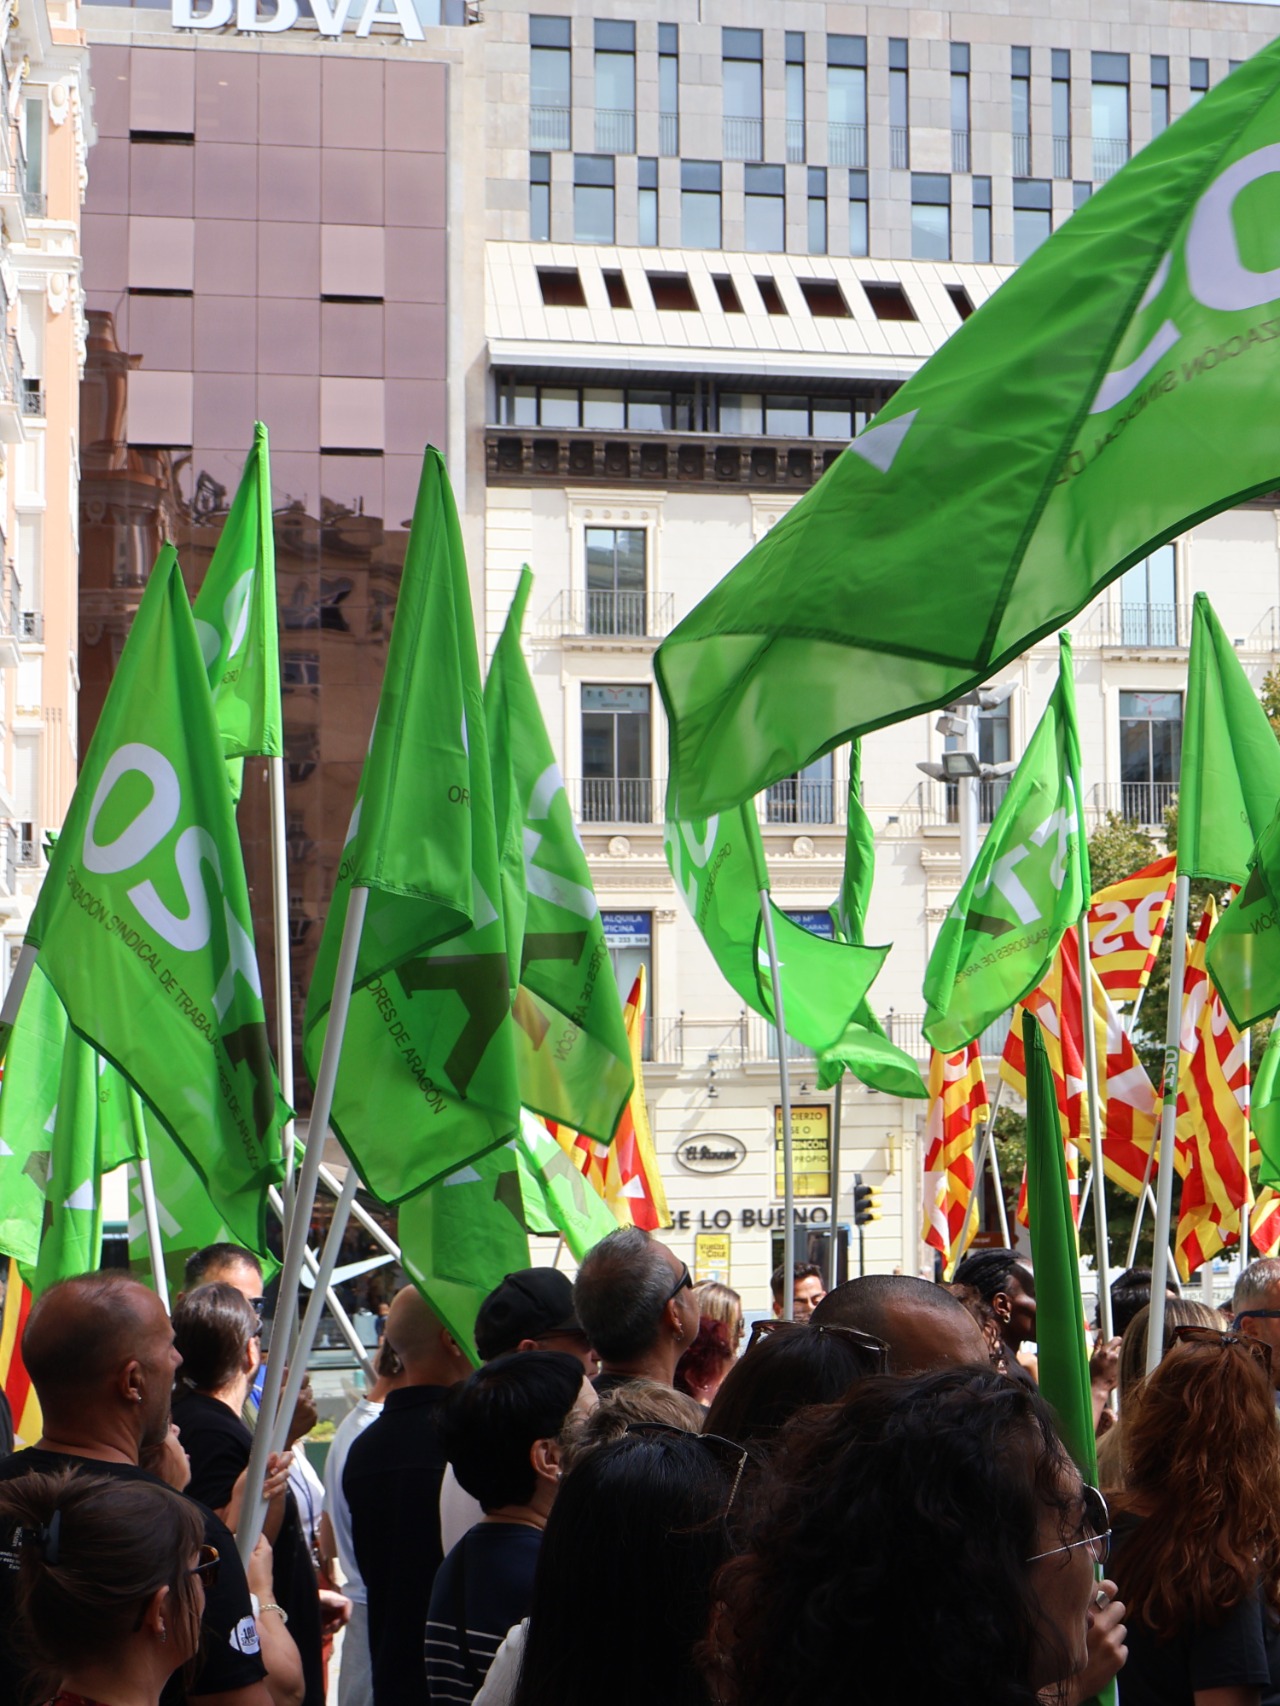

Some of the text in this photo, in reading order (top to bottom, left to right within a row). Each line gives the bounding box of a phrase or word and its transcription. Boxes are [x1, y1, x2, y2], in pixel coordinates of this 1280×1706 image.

[603, 914, 643, 924] ALQUILA
[604, 924, 636, 933] FICINA
[105, 914, 160, 976] SINDICAL
[158, 968, 178, 995] DE
[388, 1022, 411, 1048] DE
[402, 1045, 448, 1116] ARAGÓN
[700, 1209, 732, 1229] LO
[741, 1207, 829, 1228] BUENO
